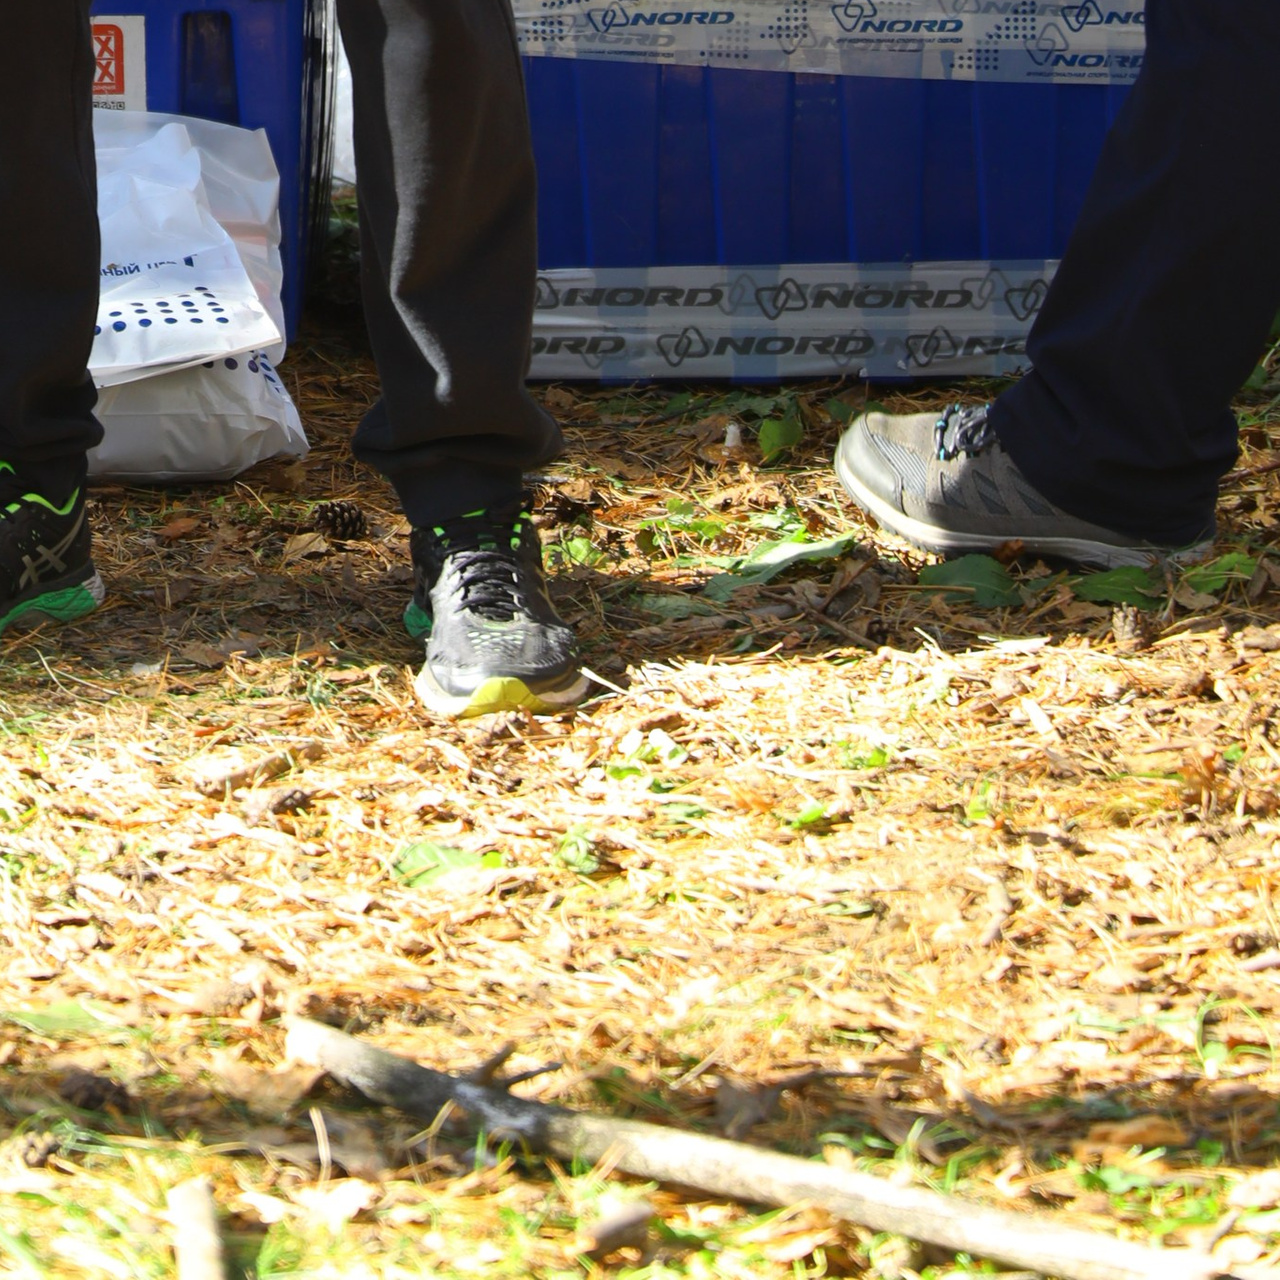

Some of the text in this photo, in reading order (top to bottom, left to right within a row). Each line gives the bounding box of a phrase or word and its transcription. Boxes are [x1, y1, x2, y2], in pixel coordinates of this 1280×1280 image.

[629, 11, 736, 26] NORD
[859, 19, 964, 33] NORD
[562, 287, 724, 307] NORD
[811, 289, 974, 309] NORD
[713, 336, 874, 355] NORD
